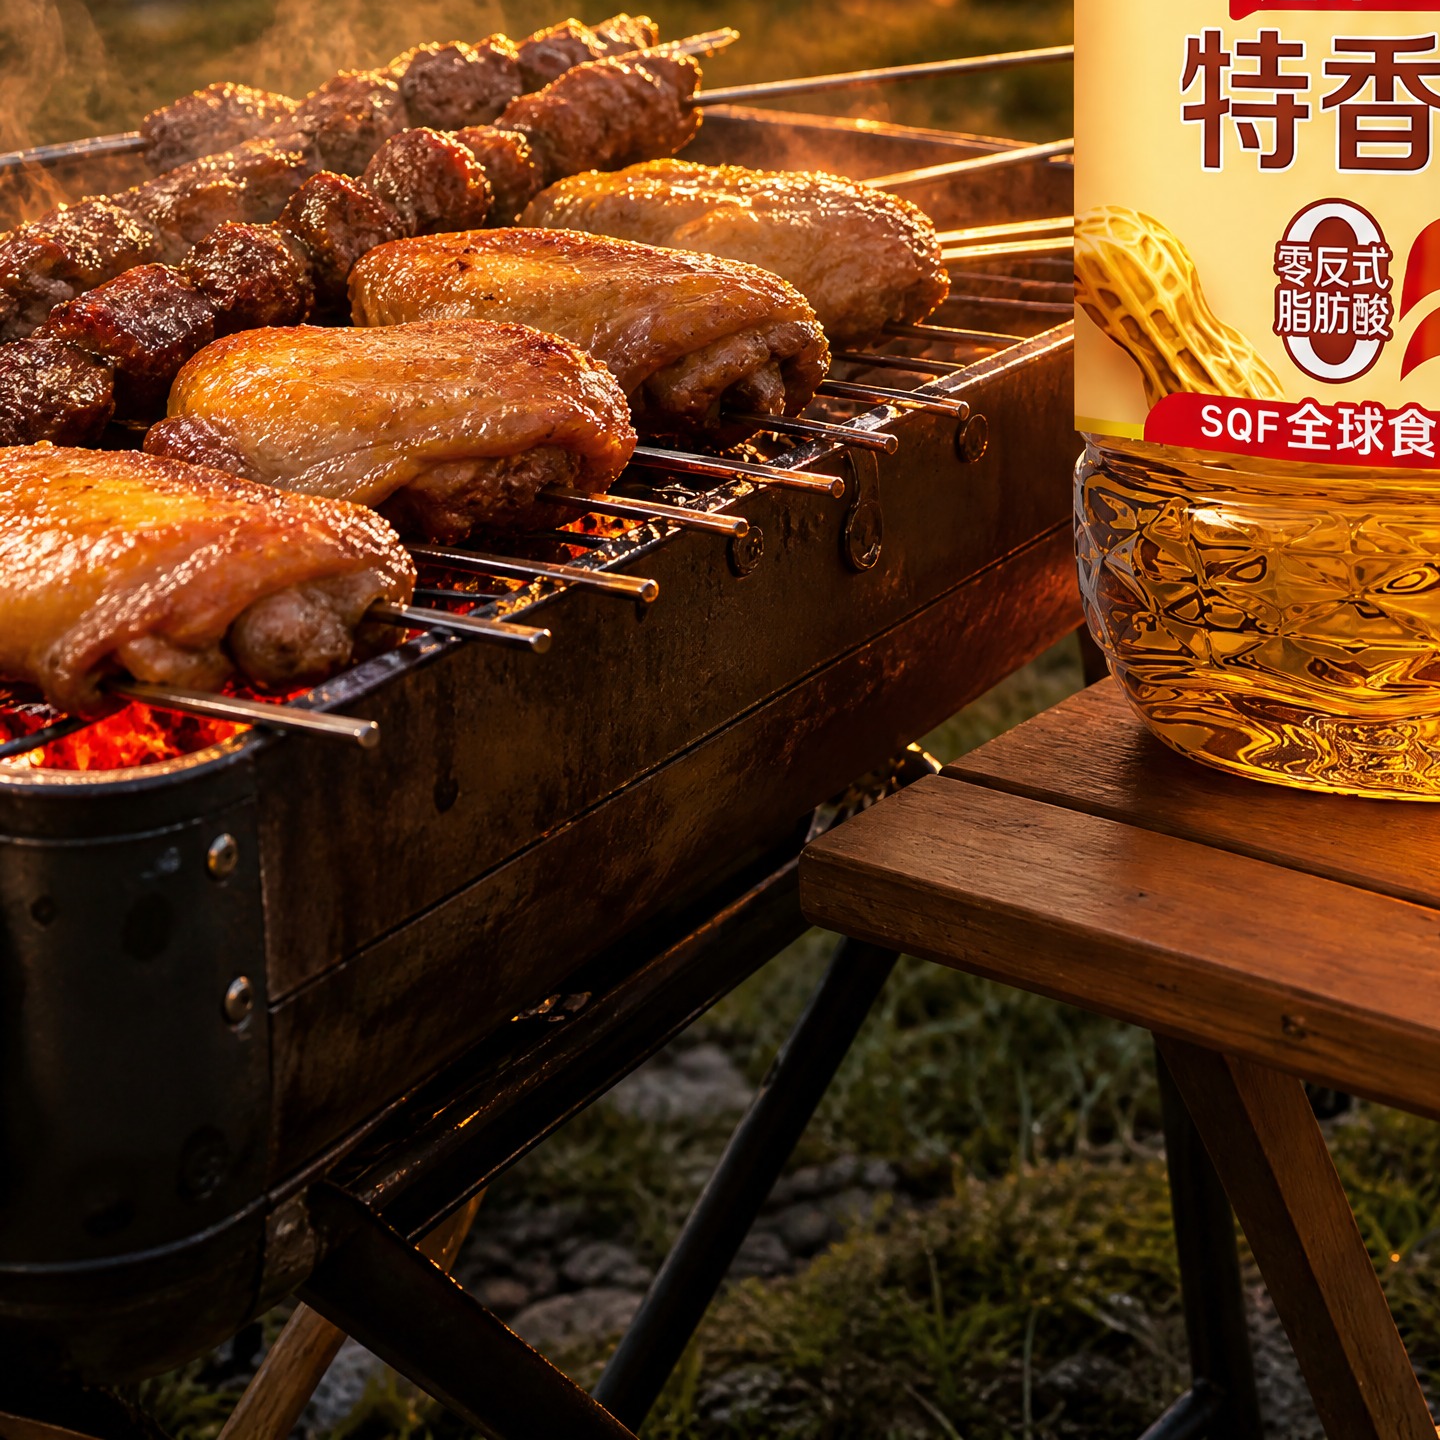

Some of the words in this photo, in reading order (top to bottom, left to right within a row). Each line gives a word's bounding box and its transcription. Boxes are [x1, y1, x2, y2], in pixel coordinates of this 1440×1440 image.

[1278, 245, 1389, 290] 零反式
[1276, 289, 1389, 337] 脂肪酸
